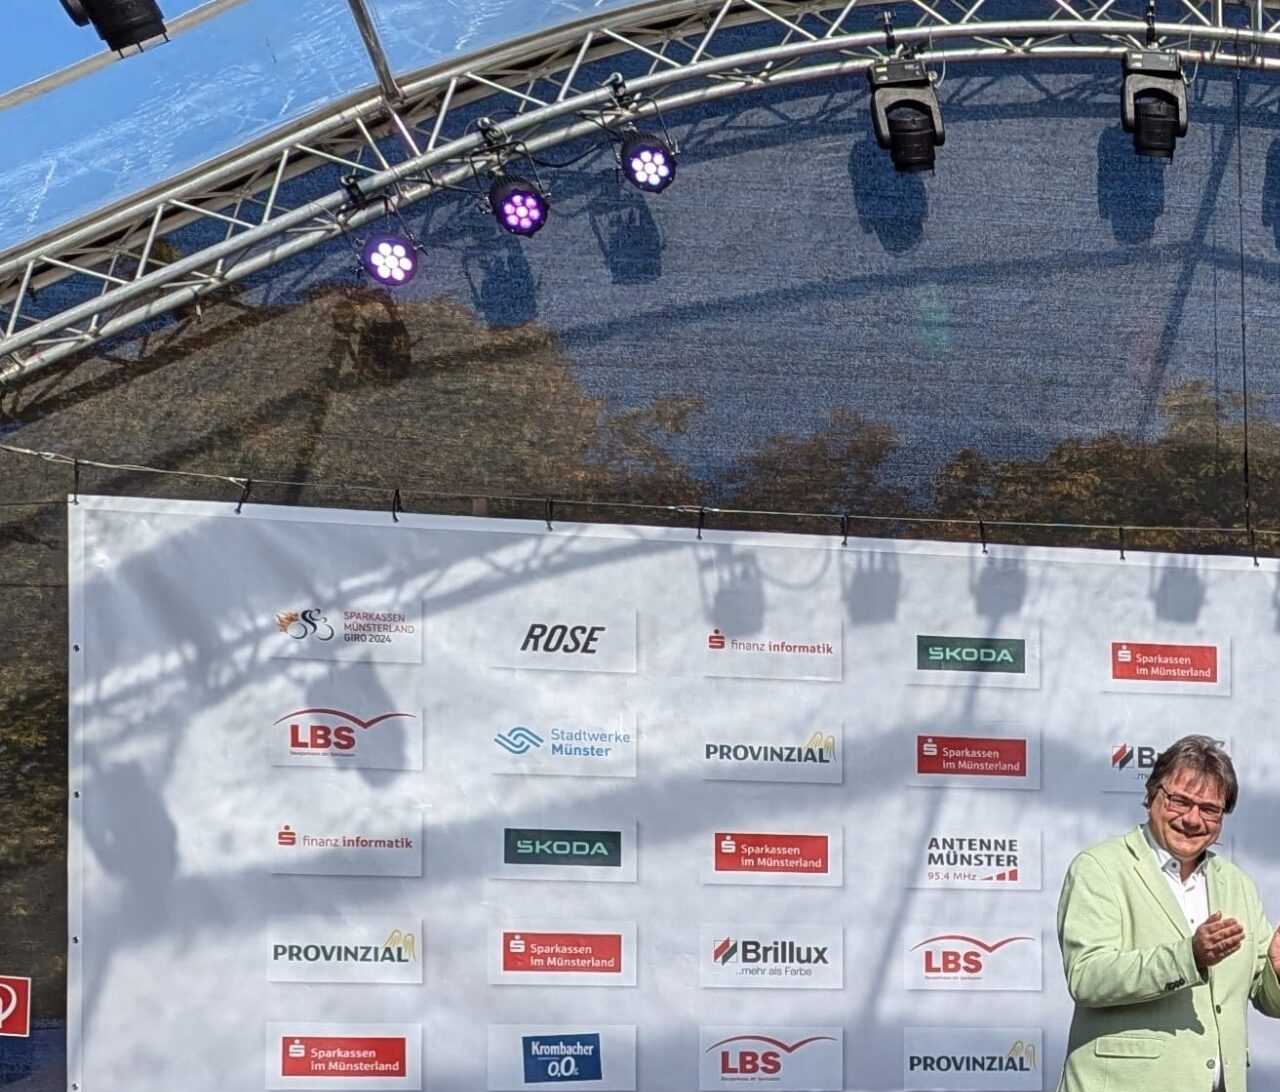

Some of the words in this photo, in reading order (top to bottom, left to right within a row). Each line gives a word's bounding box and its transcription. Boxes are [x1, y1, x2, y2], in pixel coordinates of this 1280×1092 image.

[344, 610, 405, 623] SPARKASSEN
[344, 621, 415, 634] MÜNSTERLAND
[344, 633, 365, 643] GIRO
[367, 634, 392, 644] 2024
[521, 623, 605, 654] ROSE
[731, 639, 766, 654] finanz
[768, 641, 834, 655] informatik
[1136, 652, 1191, 667] Sparkassen
[1136, 665, 1148, 675] im
[1151, 665, 1211, 678] Münsterland
[290, 724, 356, 750] LBS
[551, 728, 631, 743] Stadtwerke
[551, 742, 610, 757] Münster
[705, 743, 829, 764] PROVINZIAL
[942, 747, 1000, 760] Sparkassen
[942, 760, 955, 770] im
[958, 760, 1020, 773] Münsterland
[303, 834, 339, 848] finanz
[342, 835, 413, 849] informatik
[928, 837, 1018, 852] ANTENNE
[741, 844, 801, 857] Sparkassen
[741, 857, 753, 867] im
[757, 856, 822, 869] Münsterland
[928, 851, 1018, 867] MÜNSTER
[928, 871, 950, 881] 95.4
[952, 872, 977, 881] MHz
[273, 943, 408, 963] PROVINZIAL
[530, 943, 592, 957] Sparkassen
[741, 941, 828, 965] Brillux
[530, 956, 543, 967] im
[546, 956, 615, 969] Münsterland
[925, 951, 982, 974] LBS
[768, 966, 782, 977] als
[784, 966, 812, 977] Farbe
[310, 1047, 376, 1061] Sparkassen
[531, 1041, 594, 1057] Krombacher
[310, 1061, 324, 1072] im
[327, 1060, 399, 1073] Münsterland
[721, 1051, 781, 1074] LBS
[909, 1054, 1030, 1072] PROVINZIAL
